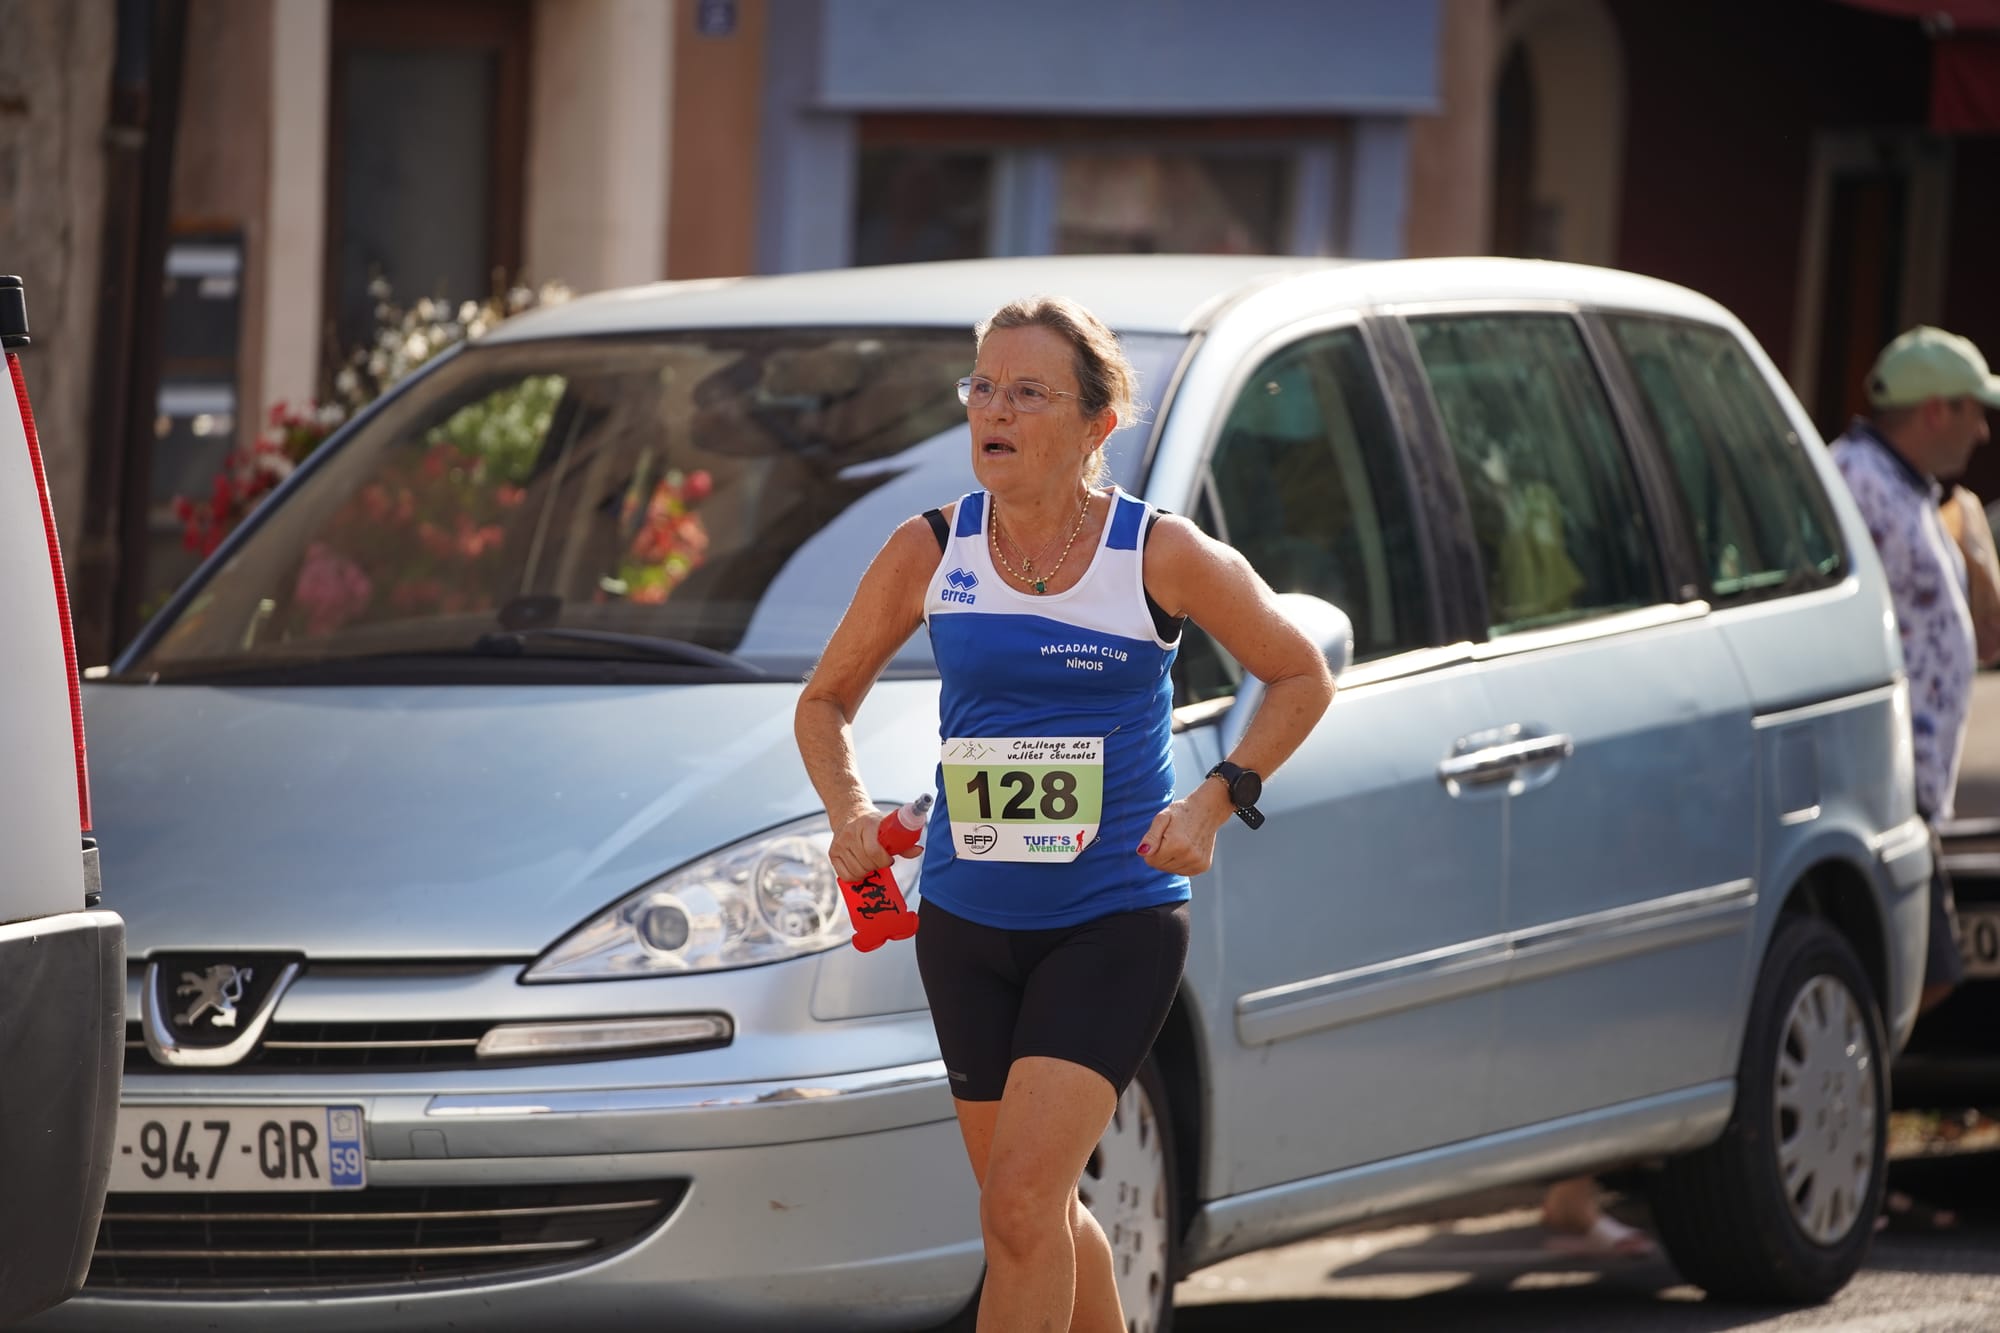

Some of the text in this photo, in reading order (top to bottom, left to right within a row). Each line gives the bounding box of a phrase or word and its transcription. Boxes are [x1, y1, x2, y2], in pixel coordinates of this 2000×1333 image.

[1040, 643, 1128, 662] MACADAM CLUB
[1013, 740, 1091, 752] Challenge des
[1007, 750, 1097, 760] vallées cévenoles
[966, 770, 1079, 820] 128
[963, 834, 993, 845] BFP
[1023, 835, 1071, 845] TUFF'S
[1028, 844, 1076, 853] Aventure
[331, 1147, 360, 1177] 59
